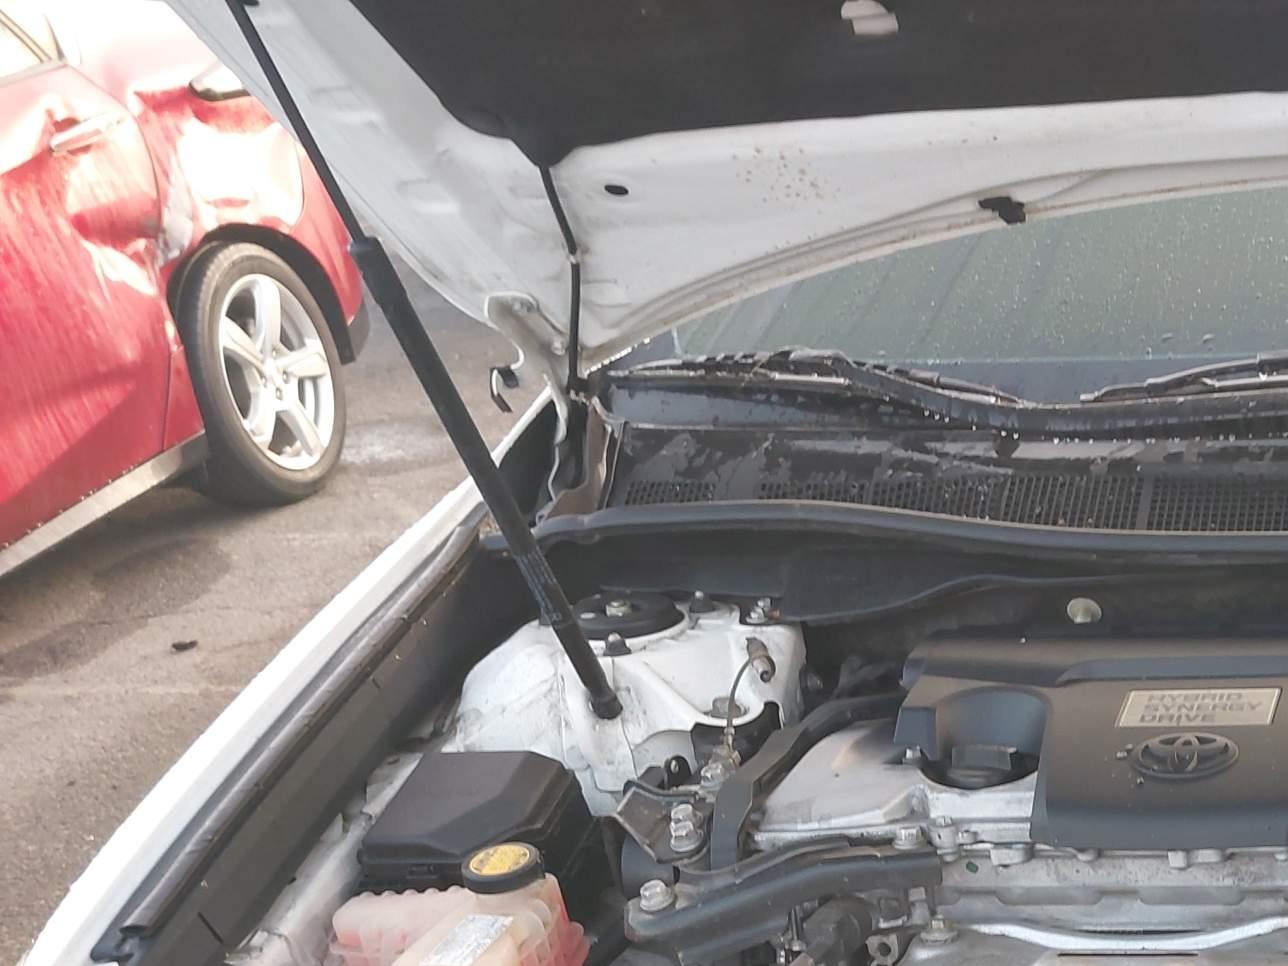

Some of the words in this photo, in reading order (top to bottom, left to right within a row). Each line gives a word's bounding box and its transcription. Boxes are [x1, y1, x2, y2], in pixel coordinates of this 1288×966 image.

[1147, 692, 1244, 703] HYBRID
[1143, 702, 1264, 713] SYNERGY
[1139, 713, 1216, 725] DRIVE
